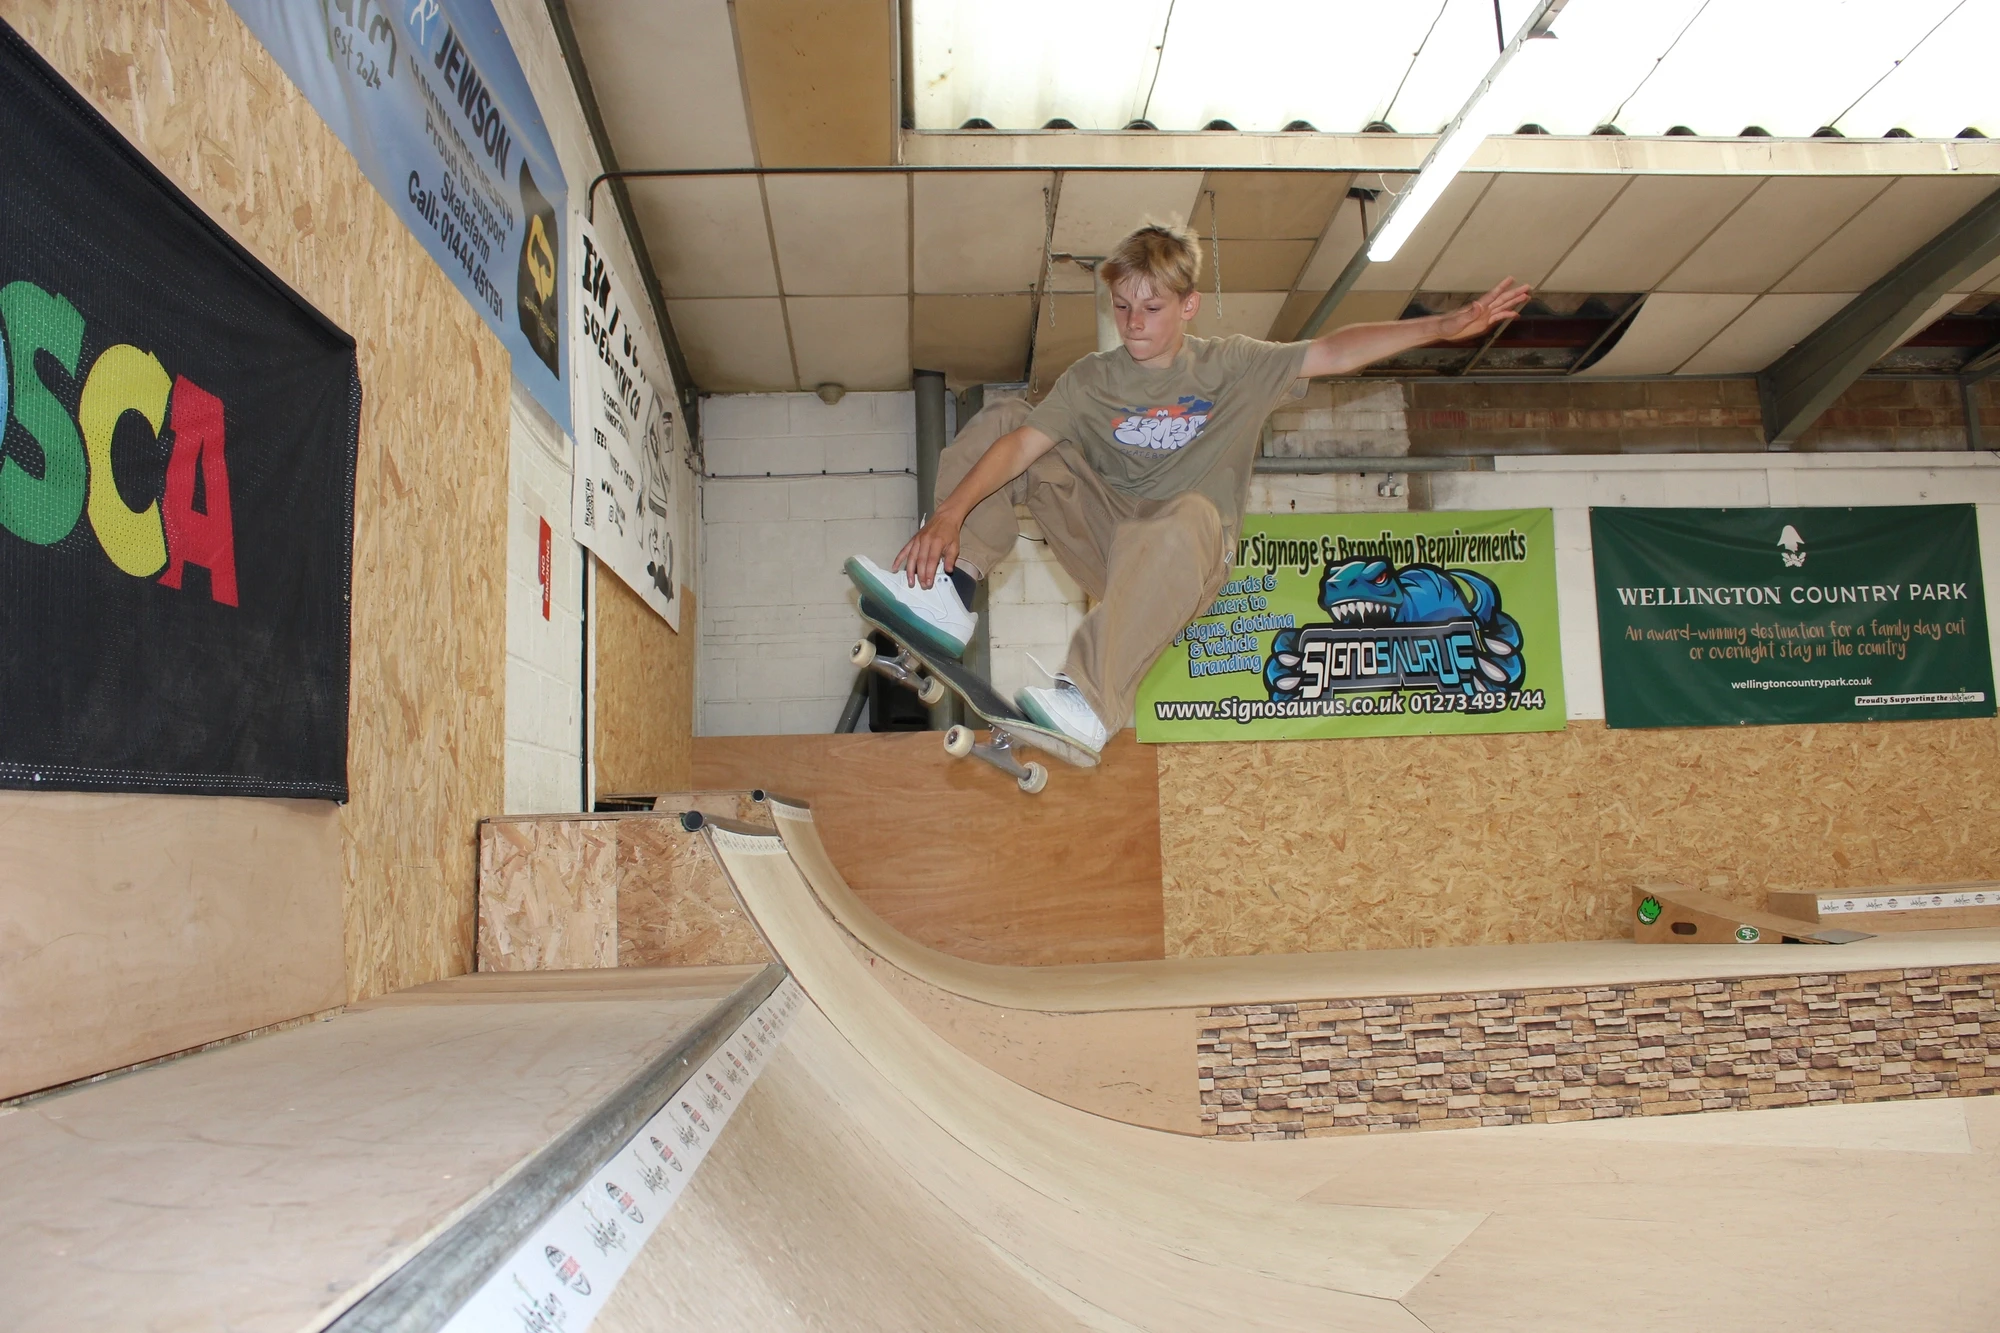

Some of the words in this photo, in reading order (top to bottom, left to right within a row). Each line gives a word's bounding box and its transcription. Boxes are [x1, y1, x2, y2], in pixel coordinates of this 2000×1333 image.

[334, 26, 353, 70] est
[357, 51, 381, 90] 2024
[435, 23, 511, 181] JEWSON
[425, 108, 457, 178] Proud
[460, 163, 470, 196] to
[472, 188, 506, 253] support
[441, 171, 490, 264] Skatefarm
[408, 170, 439, 231] Call:
[441, 212, 474, 279] 01444
[474, 264, 503, 322] 451751
[0, 280, 238, 608] SCA
[1252, 533, 1318, 575] Signage
[1321, 537, 1337, 566] &
[1337, 532, 1414, 564] Branding
[1416, 529, 1526, 565] Requirements
[1264, 576, 1277, 590] &
[1616, 586, 1781, 606] WELLINGTON
[1790, 584, 1900, 604] COUNTRY
[1909, 583, 1968, 600] PARK
[1250, 596, 1267, 610] to
[1186, 621, 1230, 642] signs,
[1233, 613, 1295, 634] clothing
[1625, 625, 1643, 641] An
[1647, 623, 1747, 645] award-winning
[1751, 622, 1825, 641] destination
[1828, 620, 1852, 638] for
[1857, 626, 1866, 637] a
[1870, 619, 1910, 641] family
[1913, 619, 1941, 641] day
[1945, 617, 1966, 636] out
[1190, 643, 1202, 658] &
[1205, 635, 1258, 655] vehicle
[1689, 647, 1704, 660] or
[1709, 640, 1775, 664] overnight
[1780, 640, 1812, 663] stay
[1816, 643, 1827, 656] in
[1831, 639, 1853, 657] the
[1857, 638, 1906, 660] country
[1190, 654, 1262, 678] branding
[1731, 676, 1873, 690] wellingtoncountrypark.co.uk
[1157, 693, 1404, 722] www.Signosaurus.co.uk
[1411, 694, 1468, 712] 01273
[1473, 692, 1507, 711] 493
[1511, 691, 1544, 710] 744
[1890, 694, 1935, 704] Supporting
